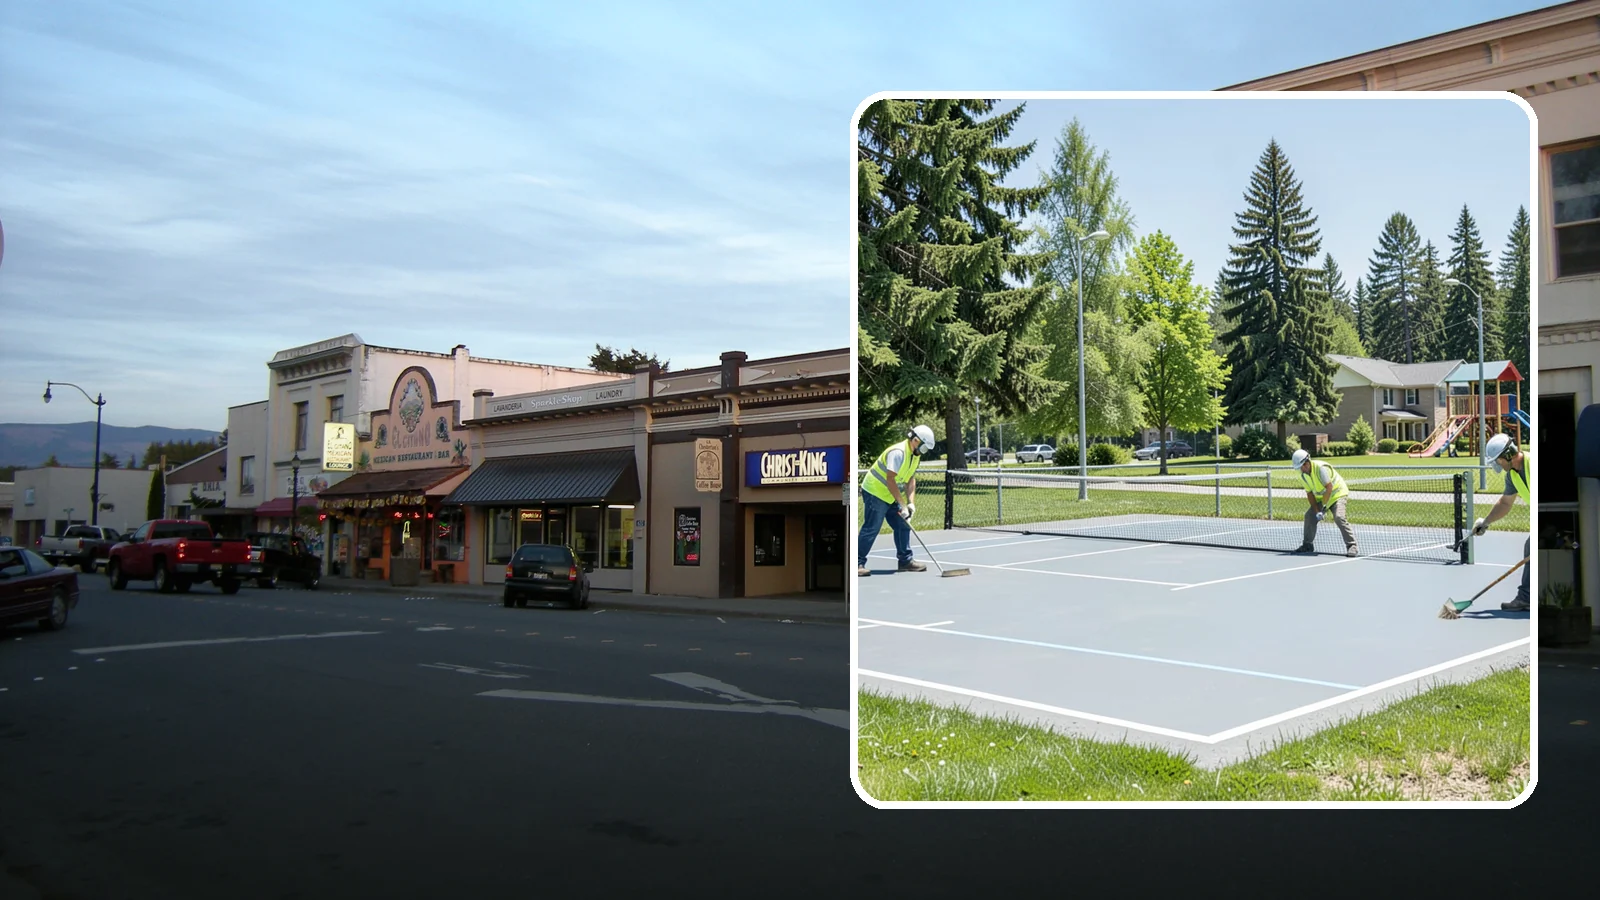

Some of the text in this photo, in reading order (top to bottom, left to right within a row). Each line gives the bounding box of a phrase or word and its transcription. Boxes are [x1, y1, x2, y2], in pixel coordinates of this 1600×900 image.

[493, 402, 522, 413] LAVANDERIA
[561, 394, 582, 405] Shop
[595, 389, 624, 400] LAUNDRY
[397, 451, 434, 462] RESTAURANT
[438, 450, 450, 459] BAR
[760, 450, 827, 478] CHRIST KING
[696, 480, 709, 489] Coffee
